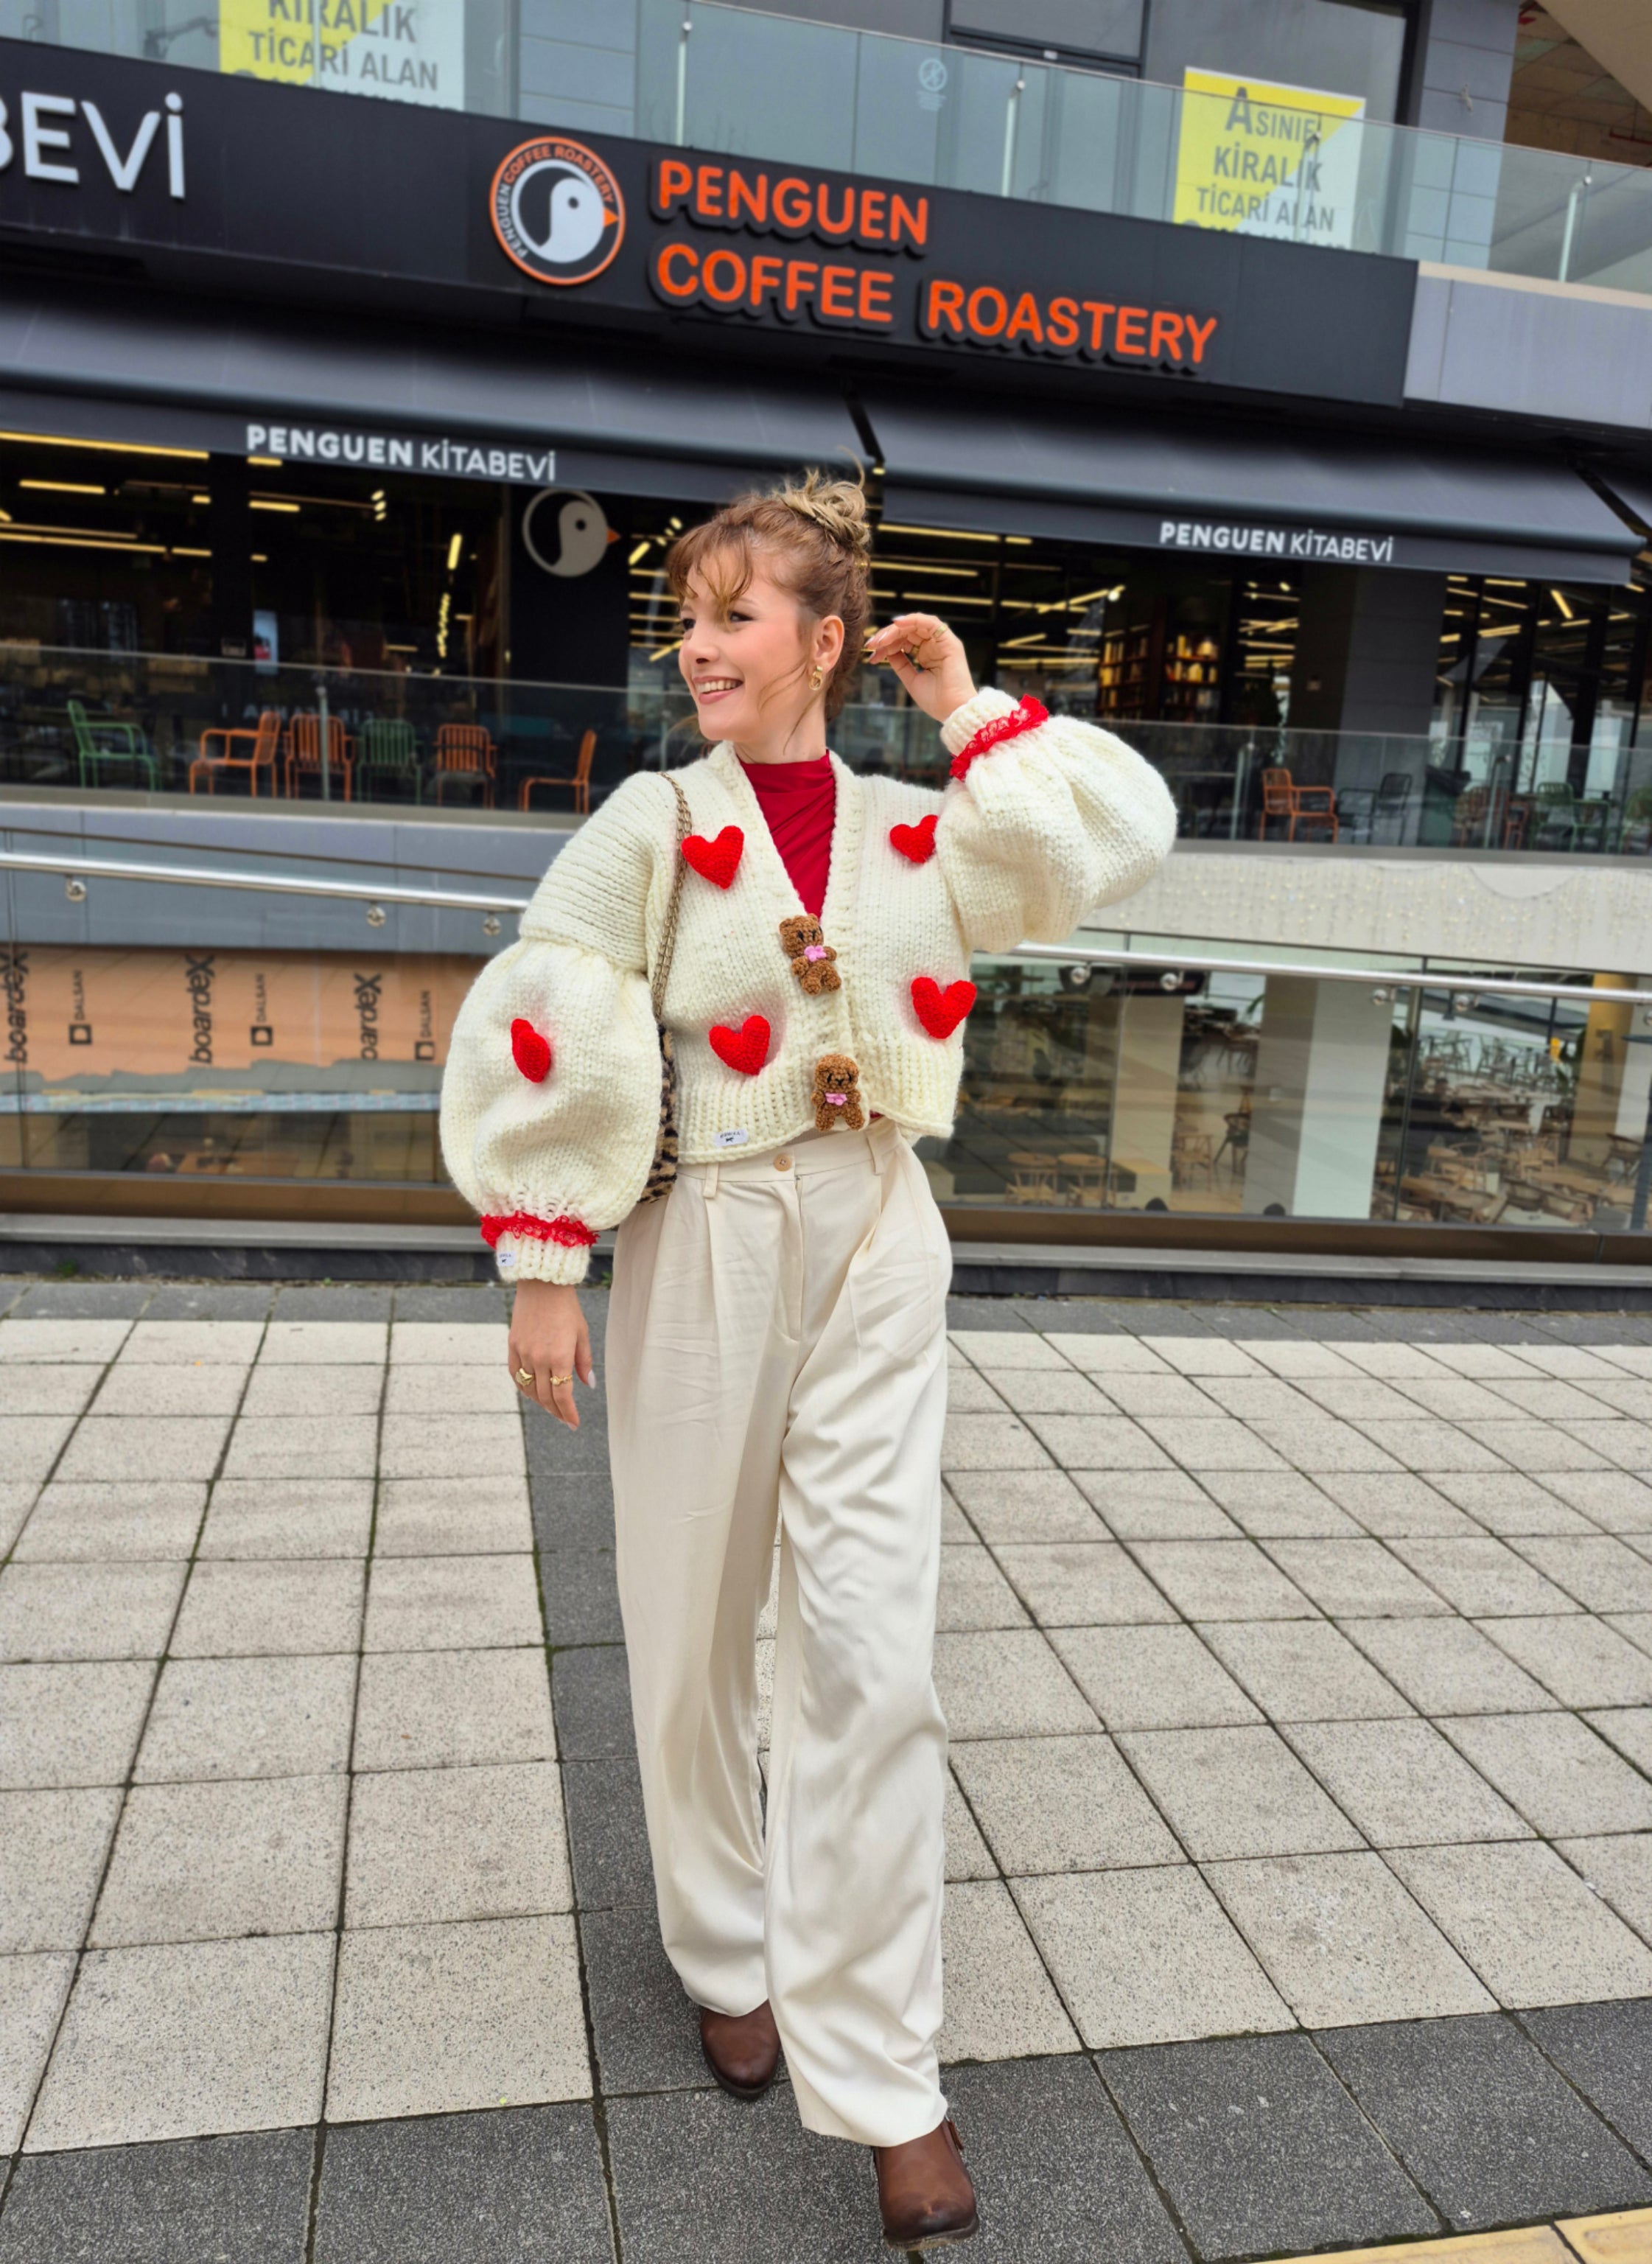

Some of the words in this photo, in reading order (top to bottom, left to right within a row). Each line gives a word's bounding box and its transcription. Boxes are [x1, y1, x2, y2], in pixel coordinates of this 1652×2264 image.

[248, 27, 349, 77] TİCARİ
[360, 51, 438, 91] ALAN
[0, 91, 185, 198] EVİ
[503, 145, 552, 184] COFFEE
[1213, 142, 1323, 192] KİRALIK
[554, 145, 615, 203] ROASTERY
[659, 160, 928, 245] PENGUEN
[497, 184, 528, 258] PENGUEN
[1196, 184, 1270, 222] TİCARİ
[1275, 200, 1334, 232] ALAN
[657, 243, 894, 323] COFFEE
[927, 280, 1217, 363] ROASTERY
[247, 424, 413, 467] PENGUEN
[421, 439, 556, 481] KİTABEVİ
[1160, 522, 1285, 553] PENGUEN
[1290, 529, 1394, 562] KİTABEVİ
[72, 969, 85, 1021] DALSAN
[255, 973, 267, 1022] DALSAN
[354, 973, 382, 1060] oardeX
[420, 990, 432, 1038] DALSAN
